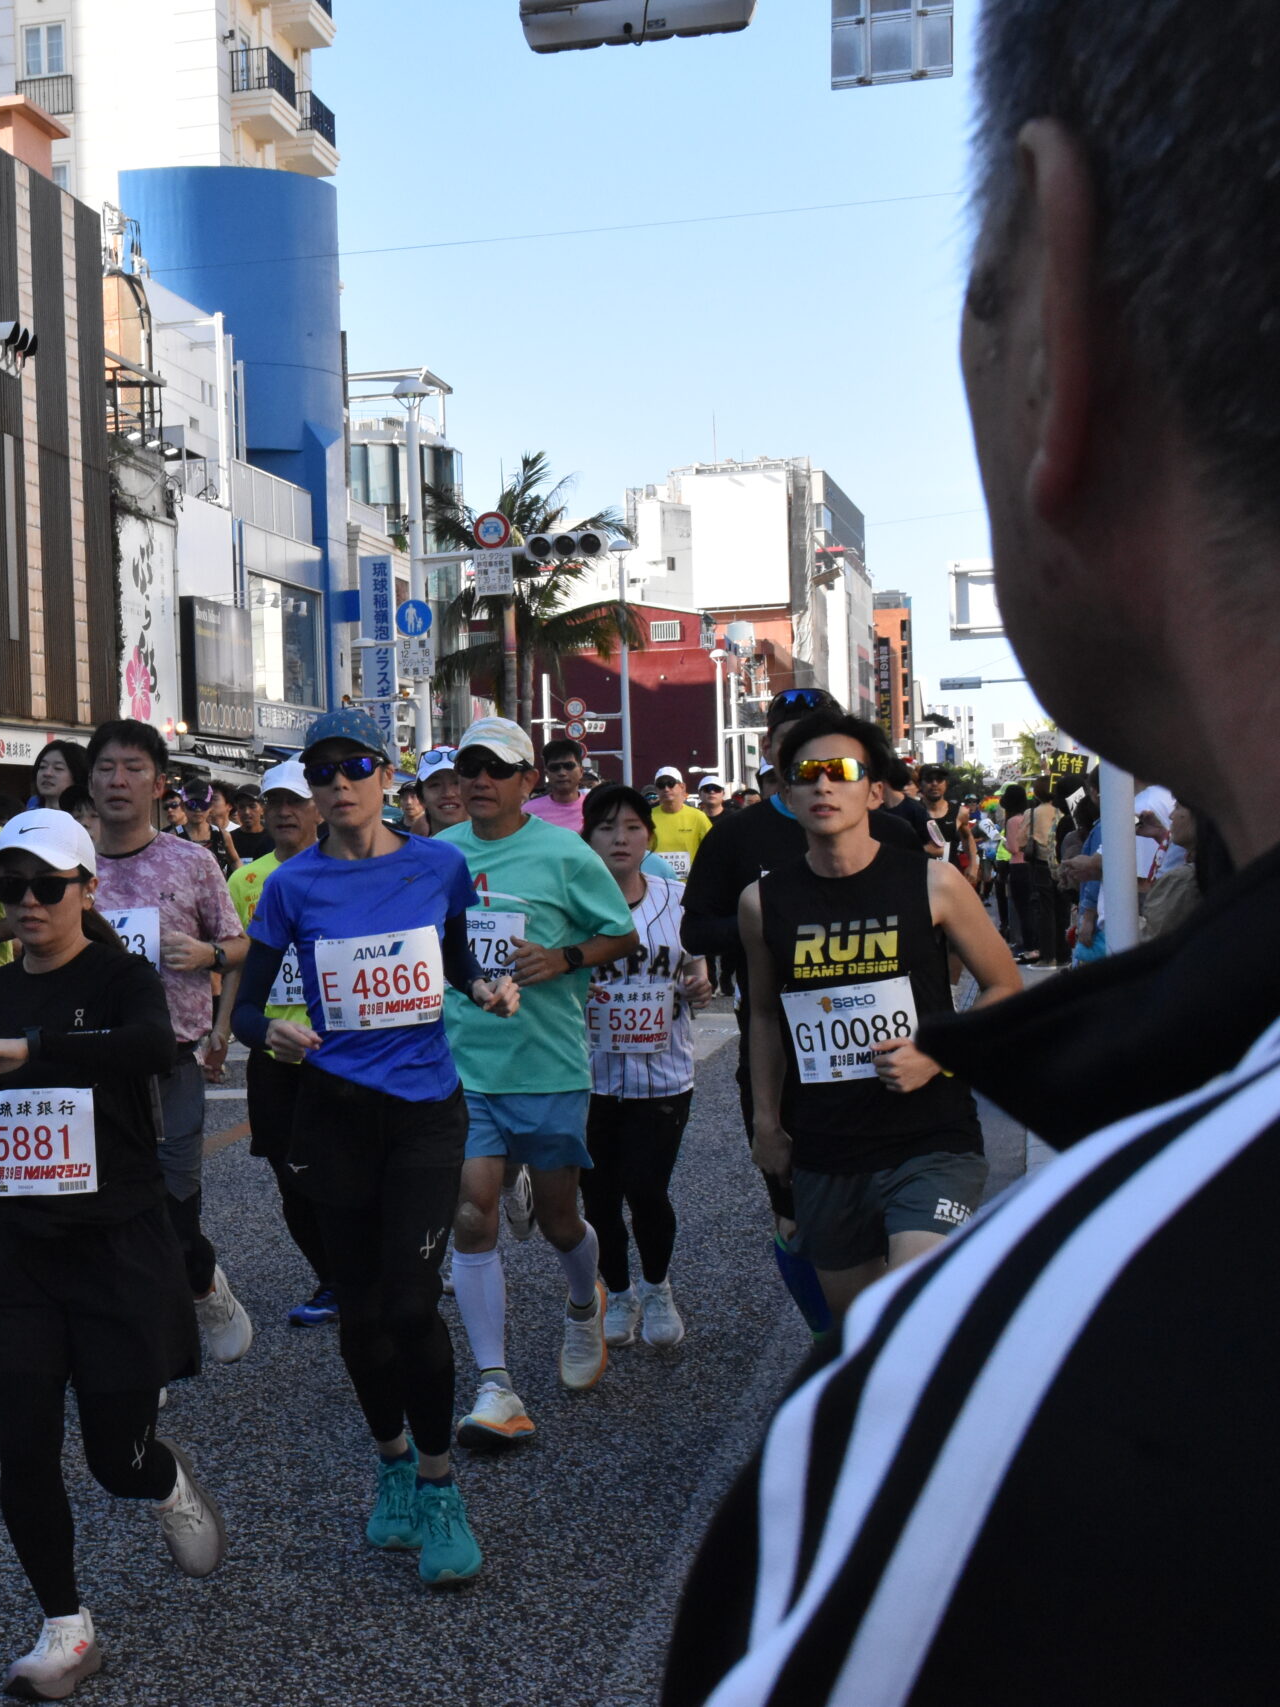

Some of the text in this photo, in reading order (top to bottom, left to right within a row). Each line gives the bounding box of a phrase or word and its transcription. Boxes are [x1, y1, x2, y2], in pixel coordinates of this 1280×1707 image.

[6, 742, 32, 759] 琉球銀行
[793, 915, 899, 965] RUN
[353, 945, 387, 961] ANA
[793, 960, 899, 979] BEAMS DESIGN
[321, 960, 431, 1002] E 4866
[613, 991, 666, 1003] 琉球銀行
[832, 993, 876, 1009] sato
[358, 1001, 384, 1017] 第39回
[588, 1007, 665, 1031] E 5324
[0, 1099, 76, 1118] 琉球銀行
[23, 1162, 91, 1181] NAHAマラソン
